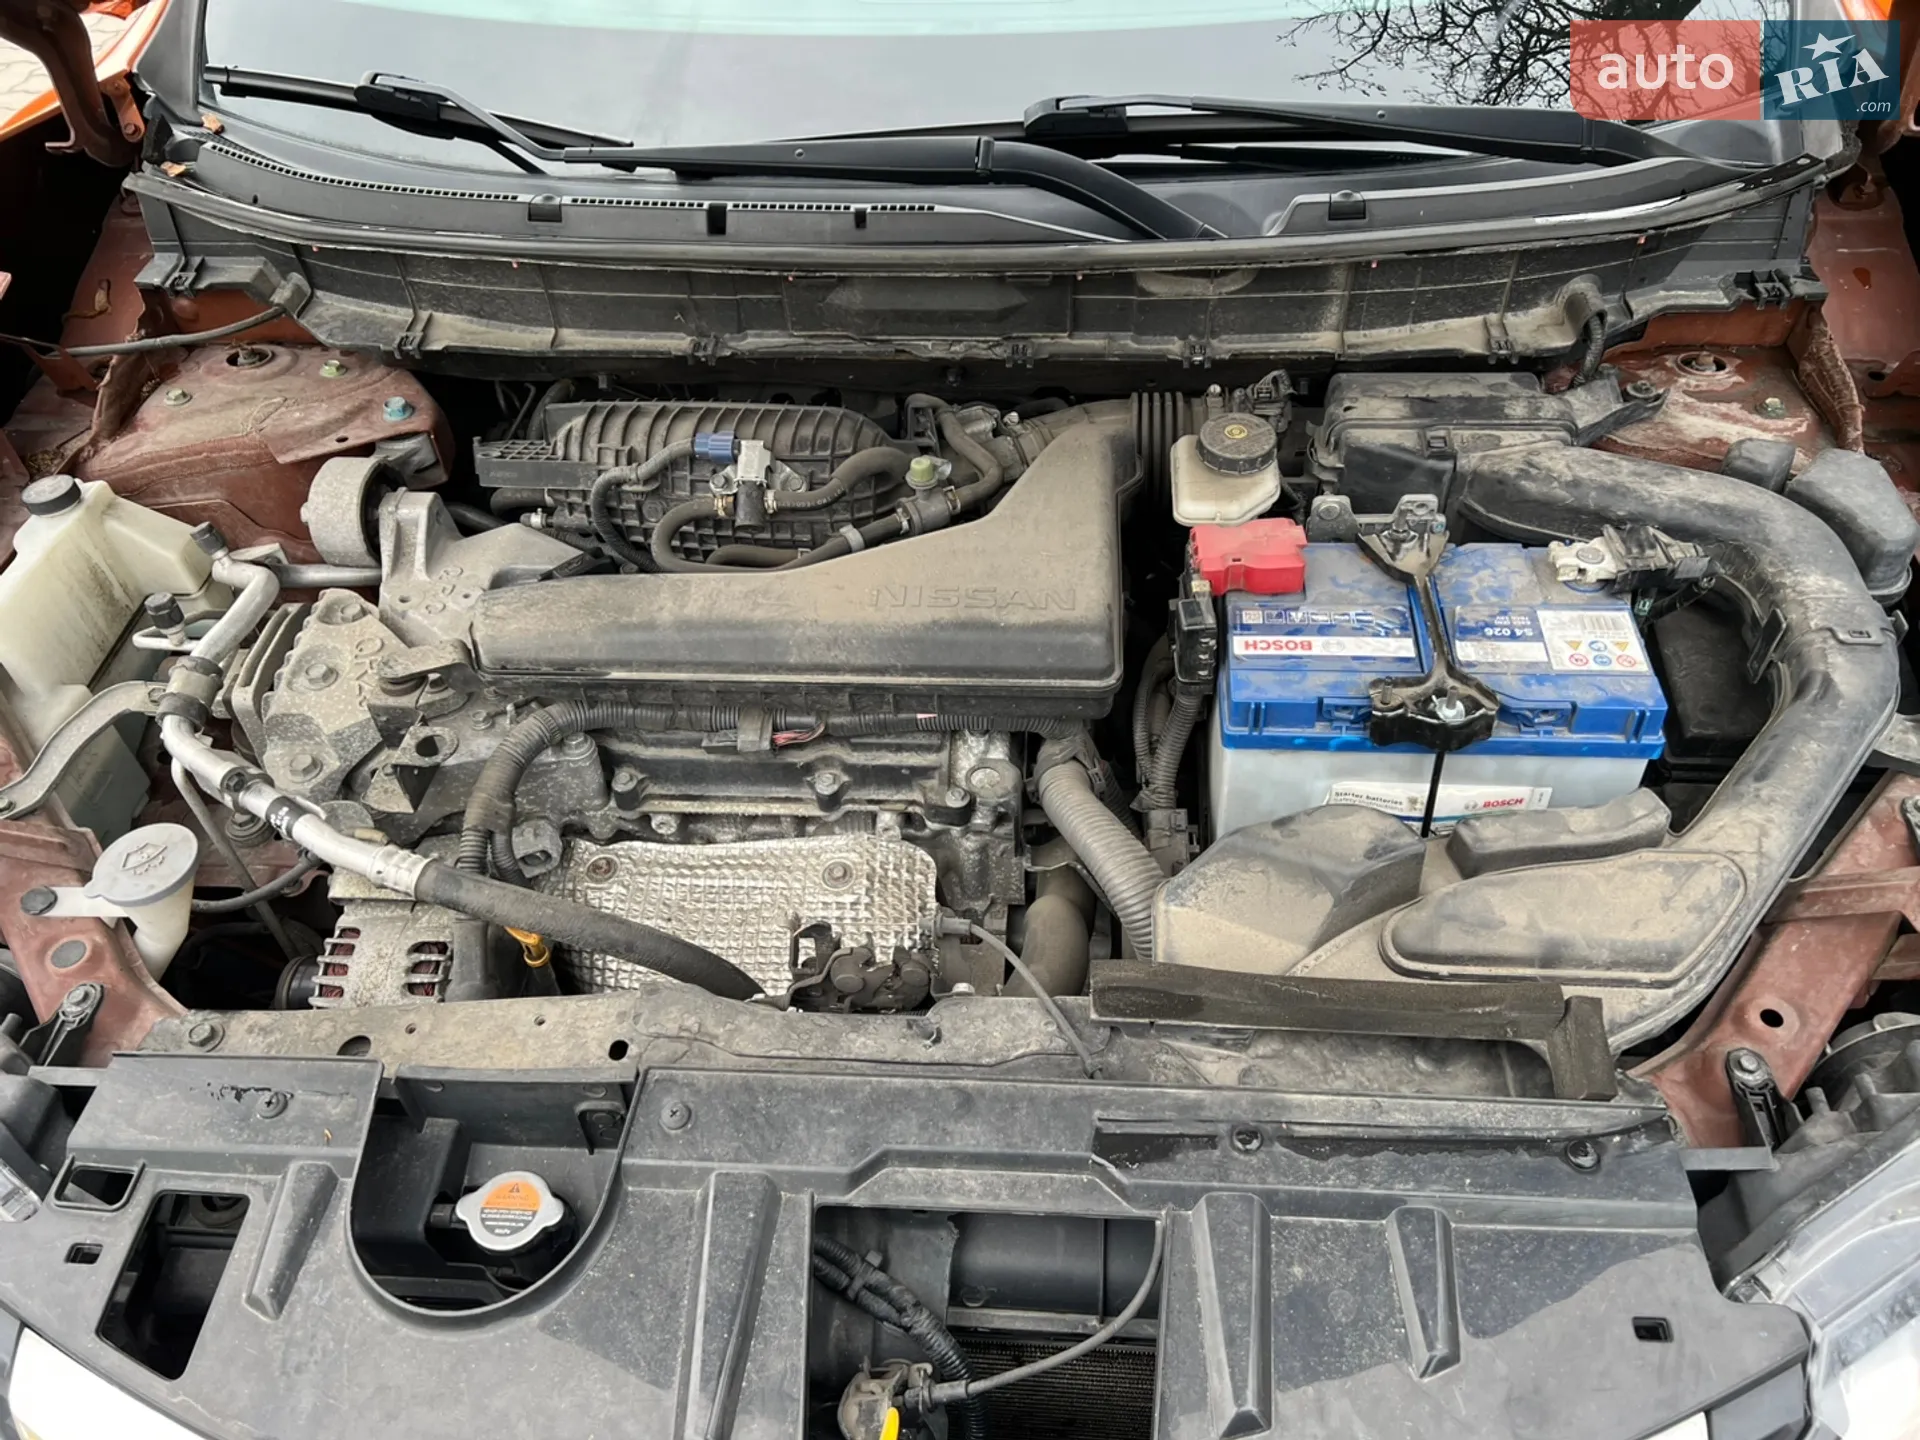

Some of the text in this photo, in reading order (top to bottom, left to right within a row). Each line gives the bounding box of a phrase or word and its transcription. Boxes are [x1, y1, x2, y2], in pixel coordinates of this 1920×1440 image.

[872, 585, 1076, 610] NISSAN
[1483, 626, 1534, 637] S4 026
[1244, 640, 1312, 651] BOSCH
[1334, 790, 1403, 806] Starter batteries
[1482, 797, 1525, 809] BOSCH
